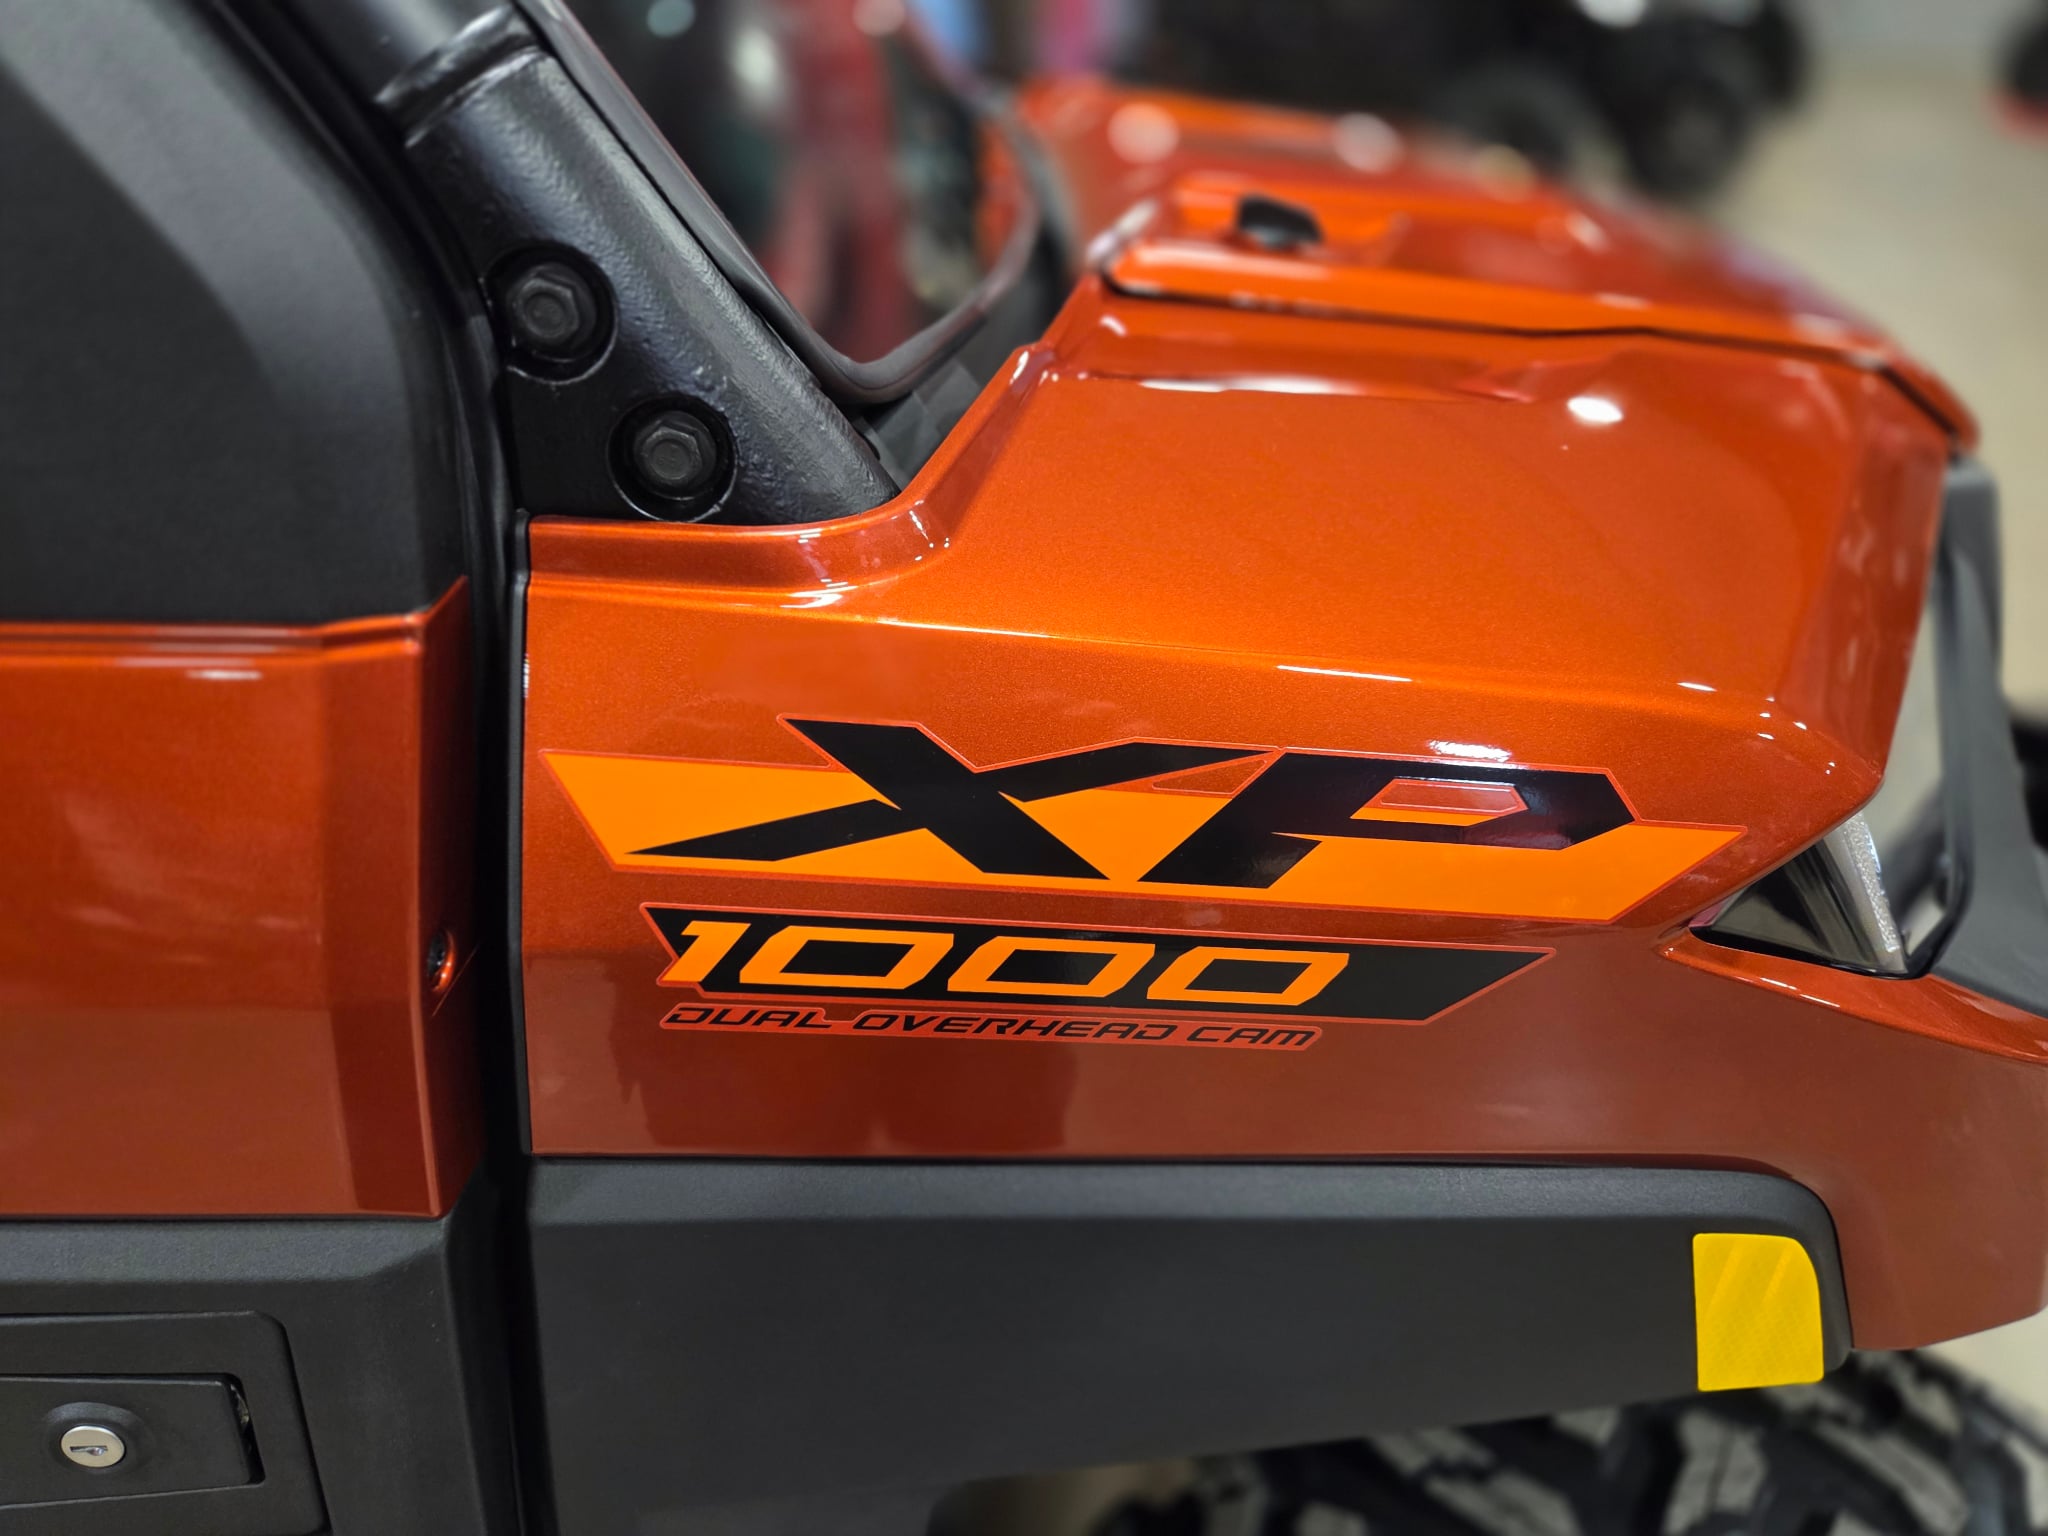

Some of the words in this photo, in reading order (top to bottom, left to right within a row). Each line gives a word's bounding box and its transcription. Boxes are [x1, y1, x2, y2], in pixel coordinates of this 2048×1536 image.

[625, 719, 1635, 889] XP
[661, 920, 1350, 1006] 1000
[665, 1007, 832, 1029] DUAL
[853, 1013, 1178, 1040] OVERHEAD
[1186, 1026, 1317, 1046] CAM
